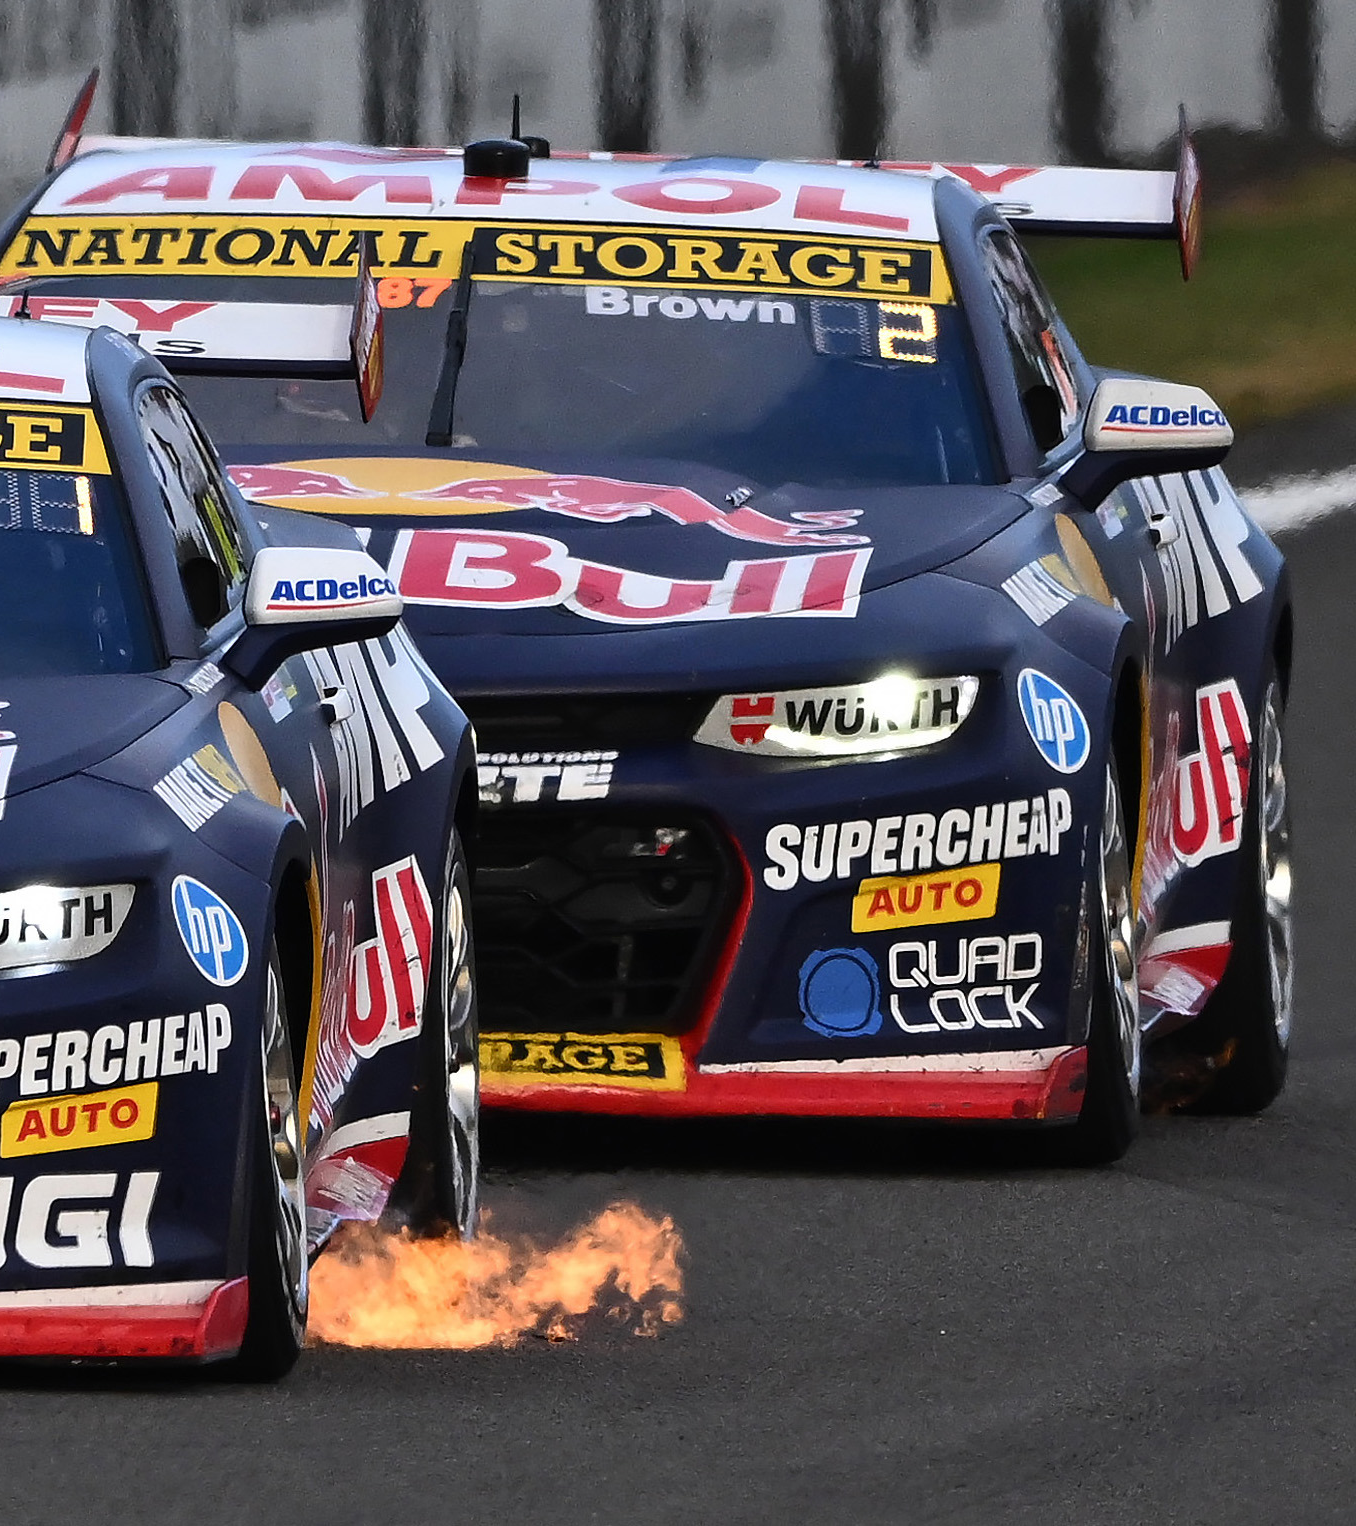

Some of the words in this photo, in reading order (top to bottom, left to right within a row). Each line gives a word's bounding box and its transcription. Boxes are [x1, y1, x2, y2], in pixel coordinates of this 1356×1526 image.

[62, 164, 910, 232] AMPOL
[16, 228, 442, 269] NATIONAL
[494, 232, 911, 294] STORAGE
[376, 277, 453, 309] 87
[585, 285, 797, 325] Brown
[387, 527, 874, 625] Bull
[1020, 670, 1084, 771] hp
[763, 788, 1072, 891] SUPERCHEAP
[867, 877, 983, 918] AUTO
[174, 876, 244, 985] hp
[888, 933, 1042, 988] QUAD
[890, 982, 1044, 1033] LOCK
[16, 1097, 140, 1142] AUTO
